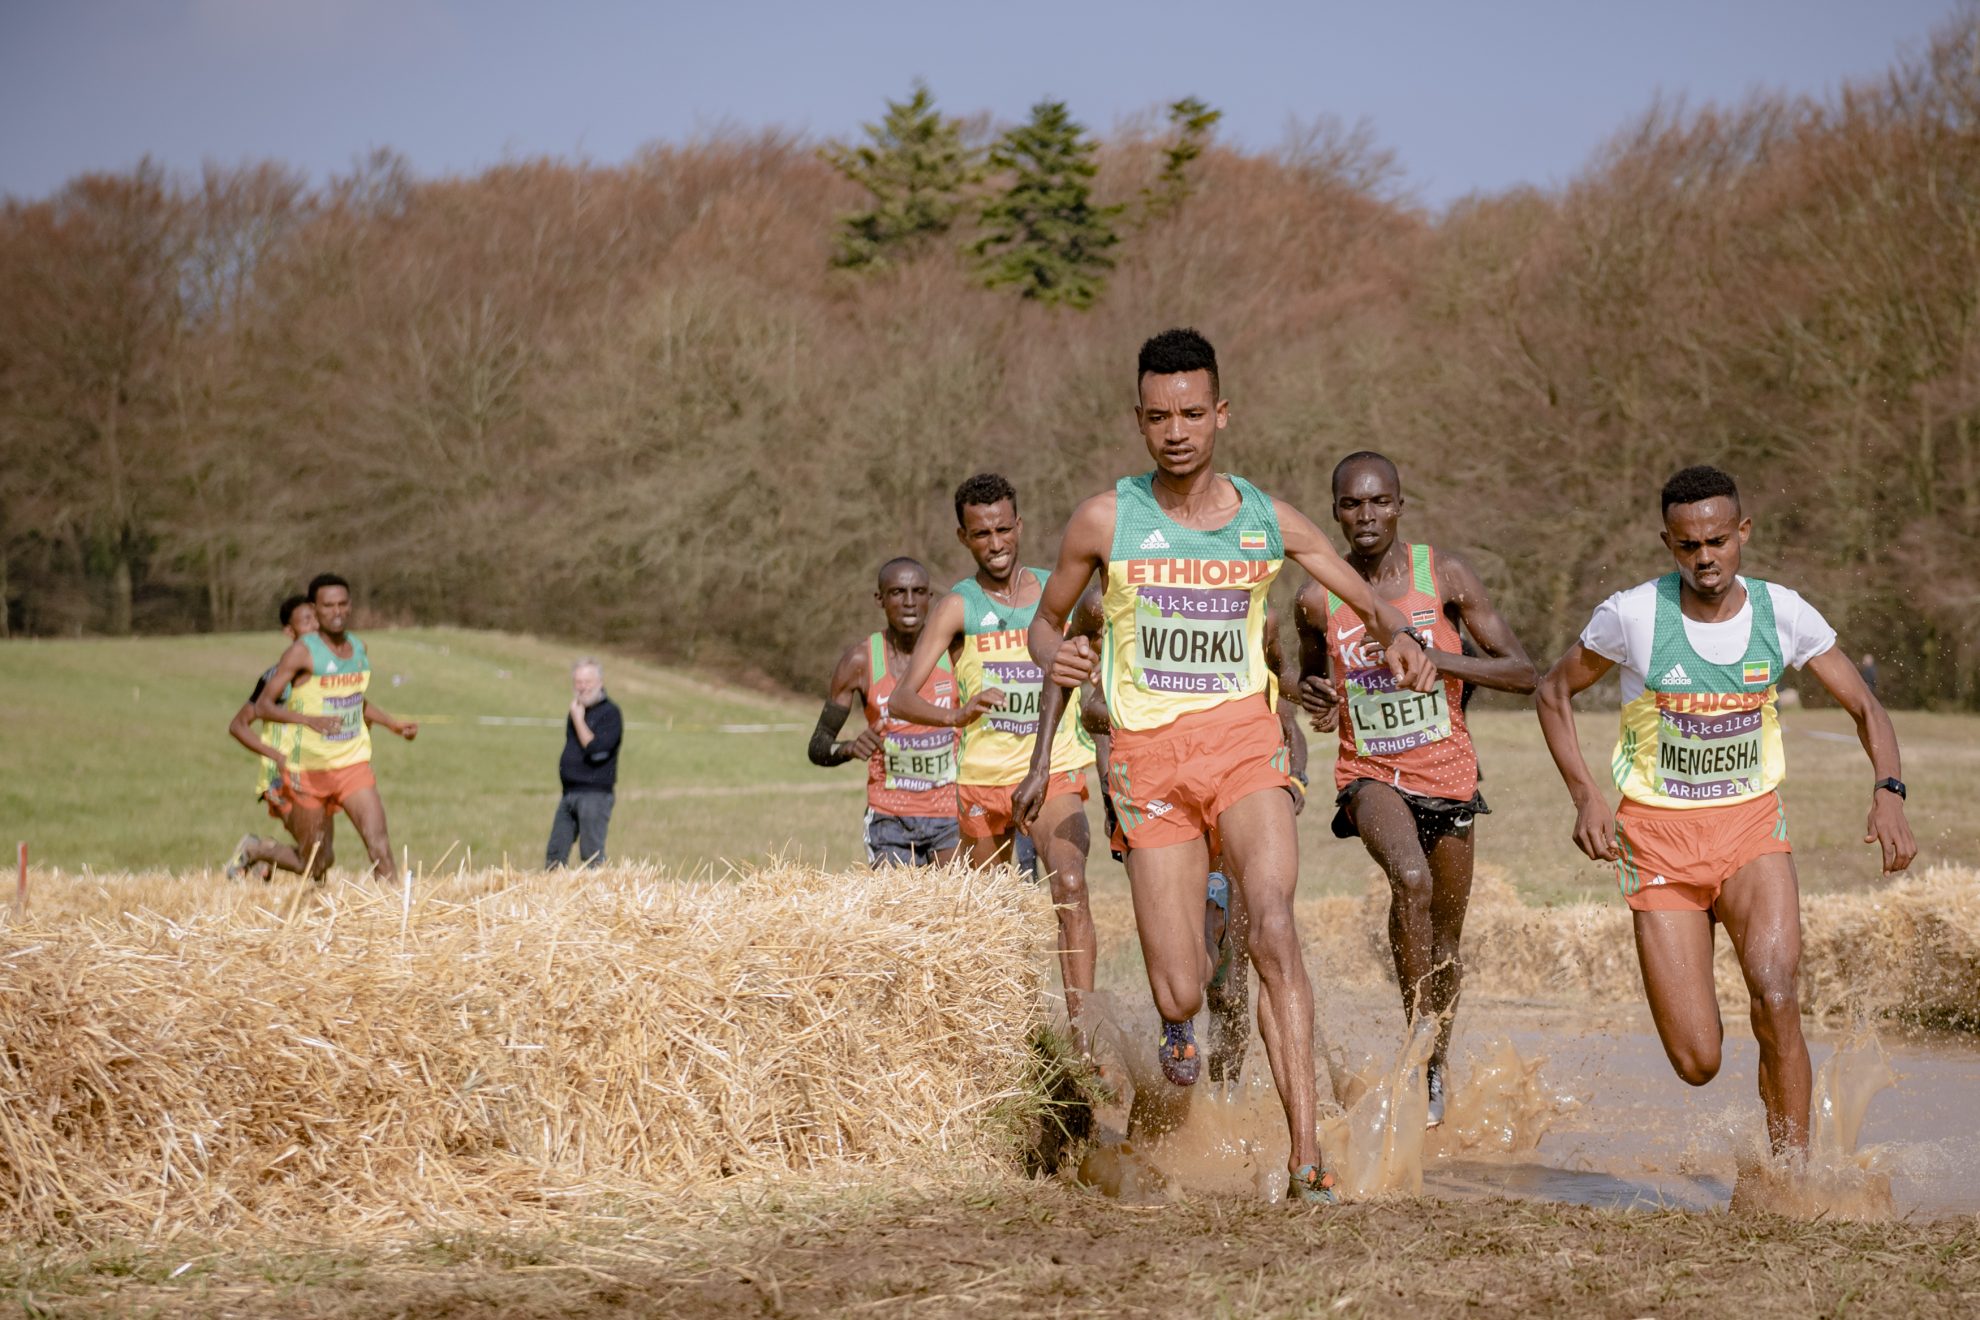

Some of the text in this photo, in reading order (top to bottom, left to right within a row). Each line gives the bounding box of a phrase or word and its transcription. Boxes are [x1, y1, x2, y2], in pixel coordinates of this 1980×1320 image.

[1139, 595, 1249, 613] Mikkeller
[975, 627, 1029, 653] ETHI
[1141, 625, 1244, 663] WORKU
[319, 671, 364, 689] ETHIOP
[985, 666, 1044, 679] Mikkel
[1137, 675, 1248, 691] AARHUS 2019
[1348, 676, 1399, 690] Mikke
[1354, 690, 1440, 731] L. BETT
[986, 719, 1033, 734] AARHUS
[1661, 710, 1761, 735] Mikkeller
[887, 731, 955, 749] Mikkeller
[1361, 723, 1449, 753] AARHUS 2019
[889, 750, 951, 775] E. BETT
[1660, 739, 1758, 776] MENGESHA
[891, 777, 933, 791] AARHUS
[1659, 777, 1761, 798] AARHUS 2019
